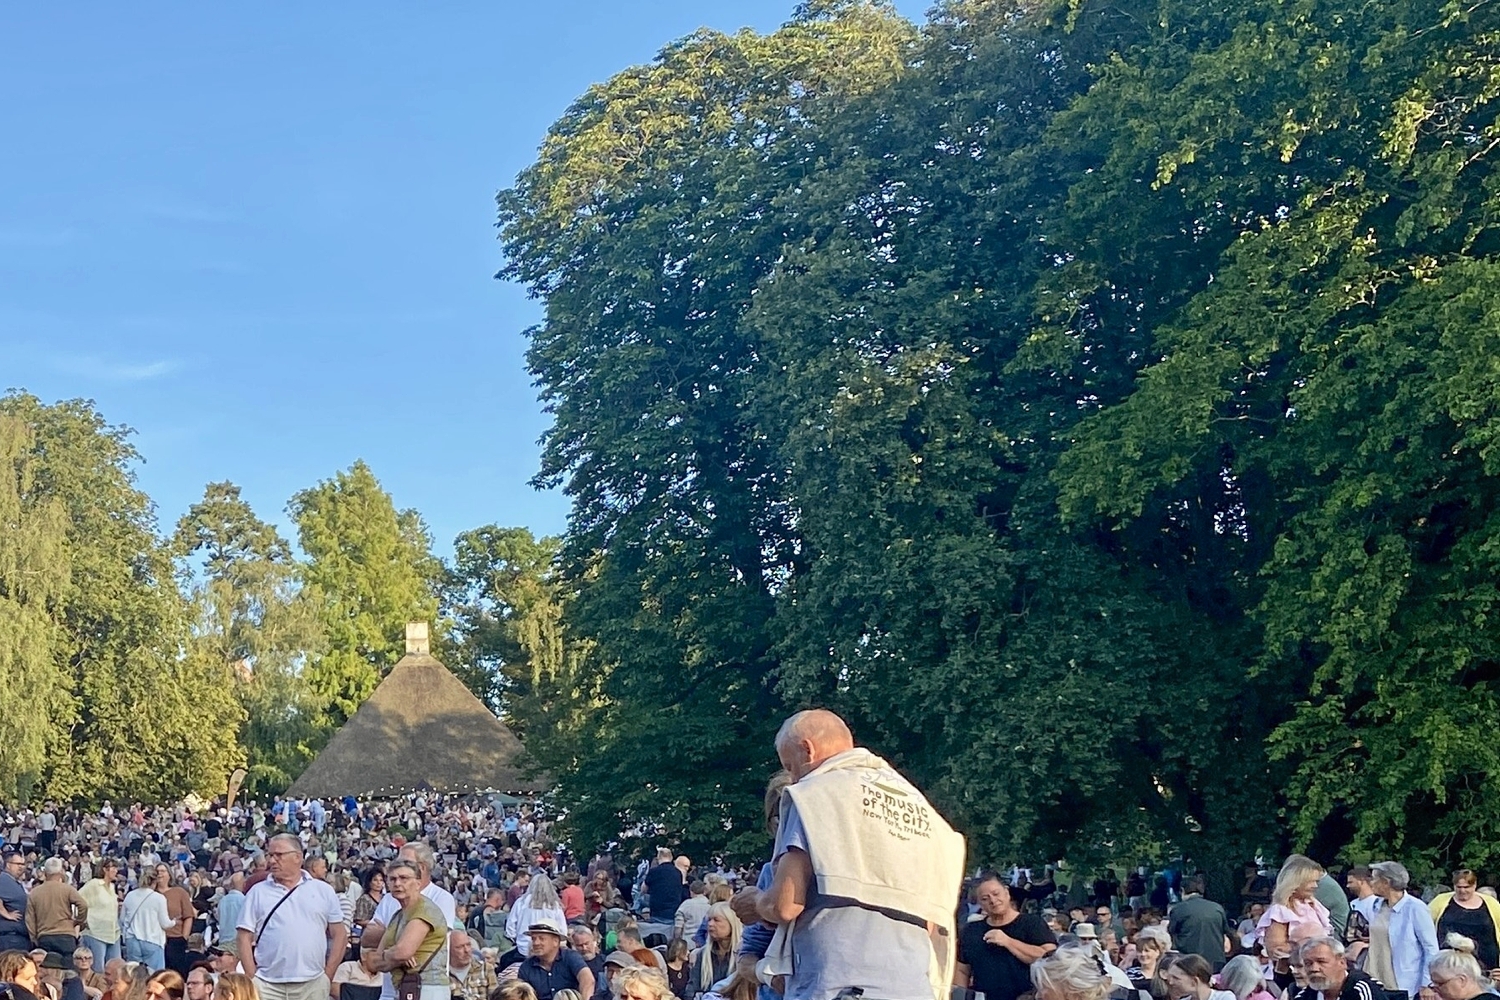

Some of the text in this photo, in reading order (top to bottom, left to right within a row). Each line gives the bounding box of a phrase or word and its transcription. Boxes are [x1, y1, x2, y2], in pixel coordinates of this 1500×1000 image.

[861, 784, 928, 818] The music
[862, 797, 877, 809] of
[880, 802, 899, 821] the
